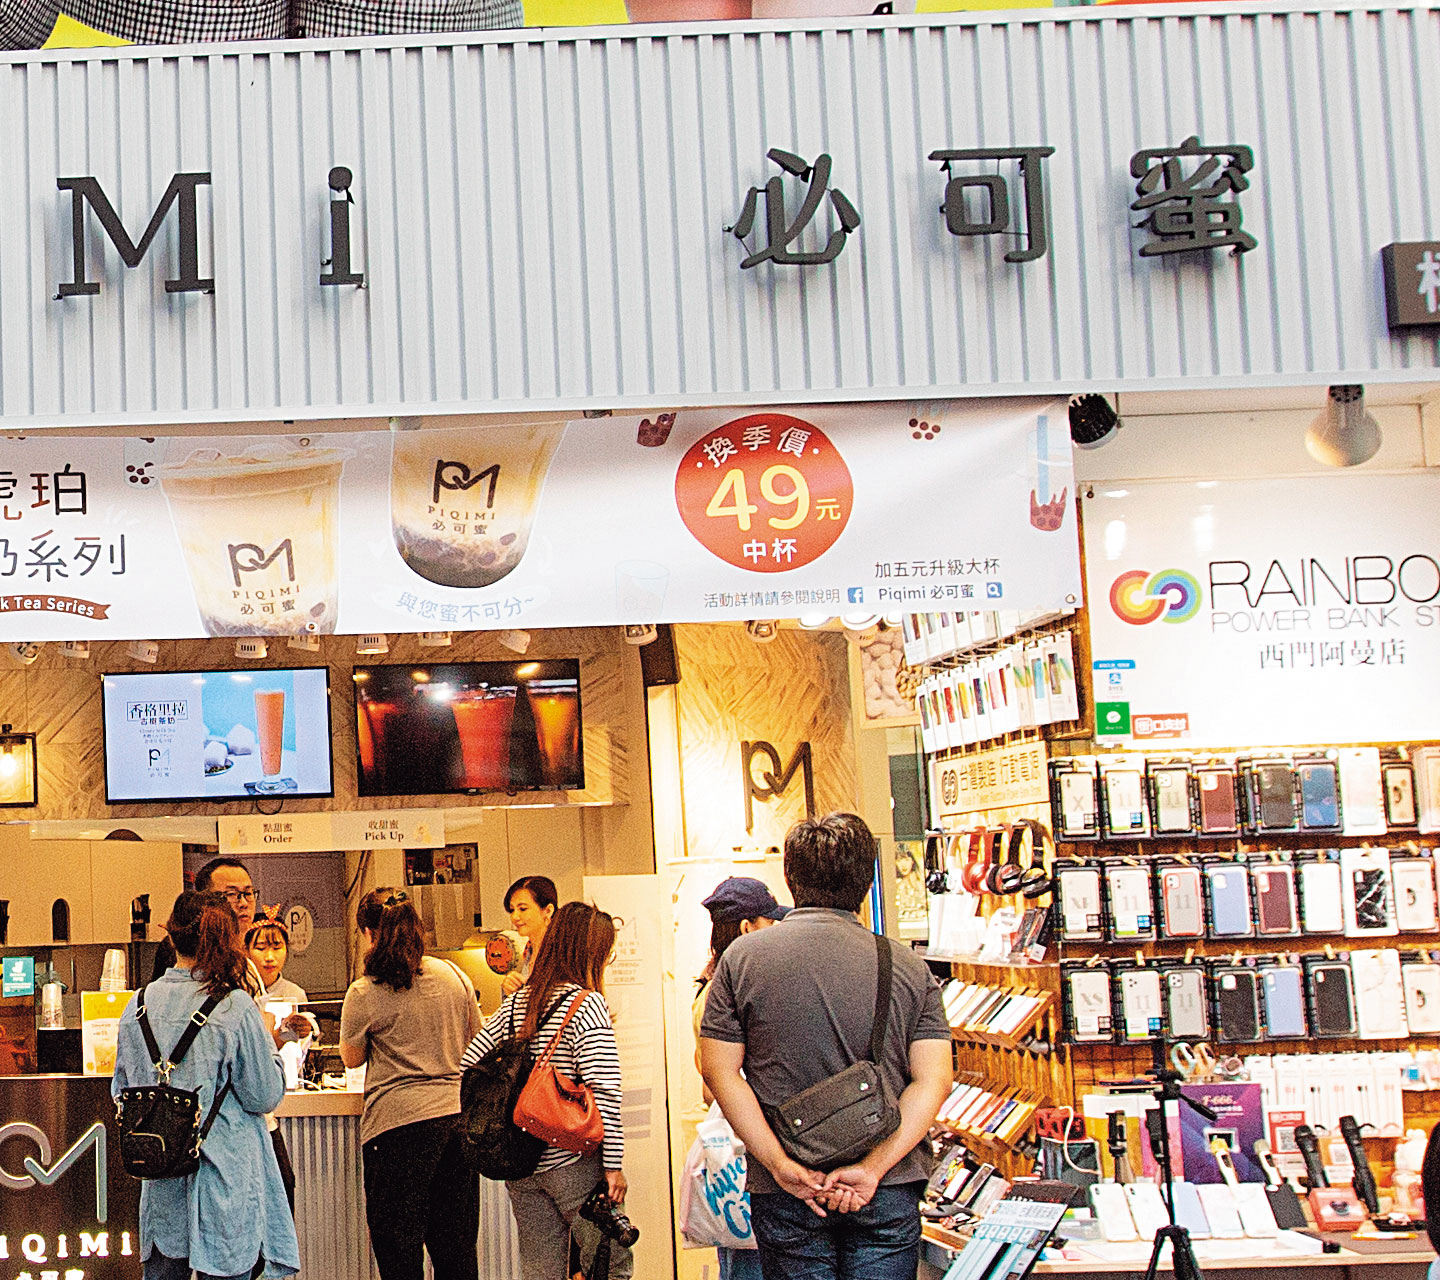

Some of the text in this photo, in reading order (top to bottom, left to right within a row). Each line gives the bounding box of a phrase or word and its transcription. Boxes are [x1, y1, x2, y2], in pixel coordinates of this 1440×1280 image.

[733, 135, 1258, 270] 必可蜜
[703, 424, 812, 470] 換季價
[706, 464, 842, 532] 49 元
[432, 521, 488, 536] 必可蜜
[742, 537, 797, 565] 中杯
[873, 558, 1002, 580] 加五元升級大杯
[13, 596, 42, 609] Tea
[47, 597, 94, 616] Series
[703, 587, 841, 607] 活動詳情請參閱說明
[878, 586, 927, 604] Piqimi
[930, 584, 976, 602] 必可蜜
[240, 600, 297, 618] 必可蜜
[1212, 609, 1312, 633] POWER
[1329, 608, 1400, 630] BANK
[1258, 638, 1407, 669] 西門阿曼店
[263, 834, 293, 843] Order
[365, 831, 404, 842] Pick Up
